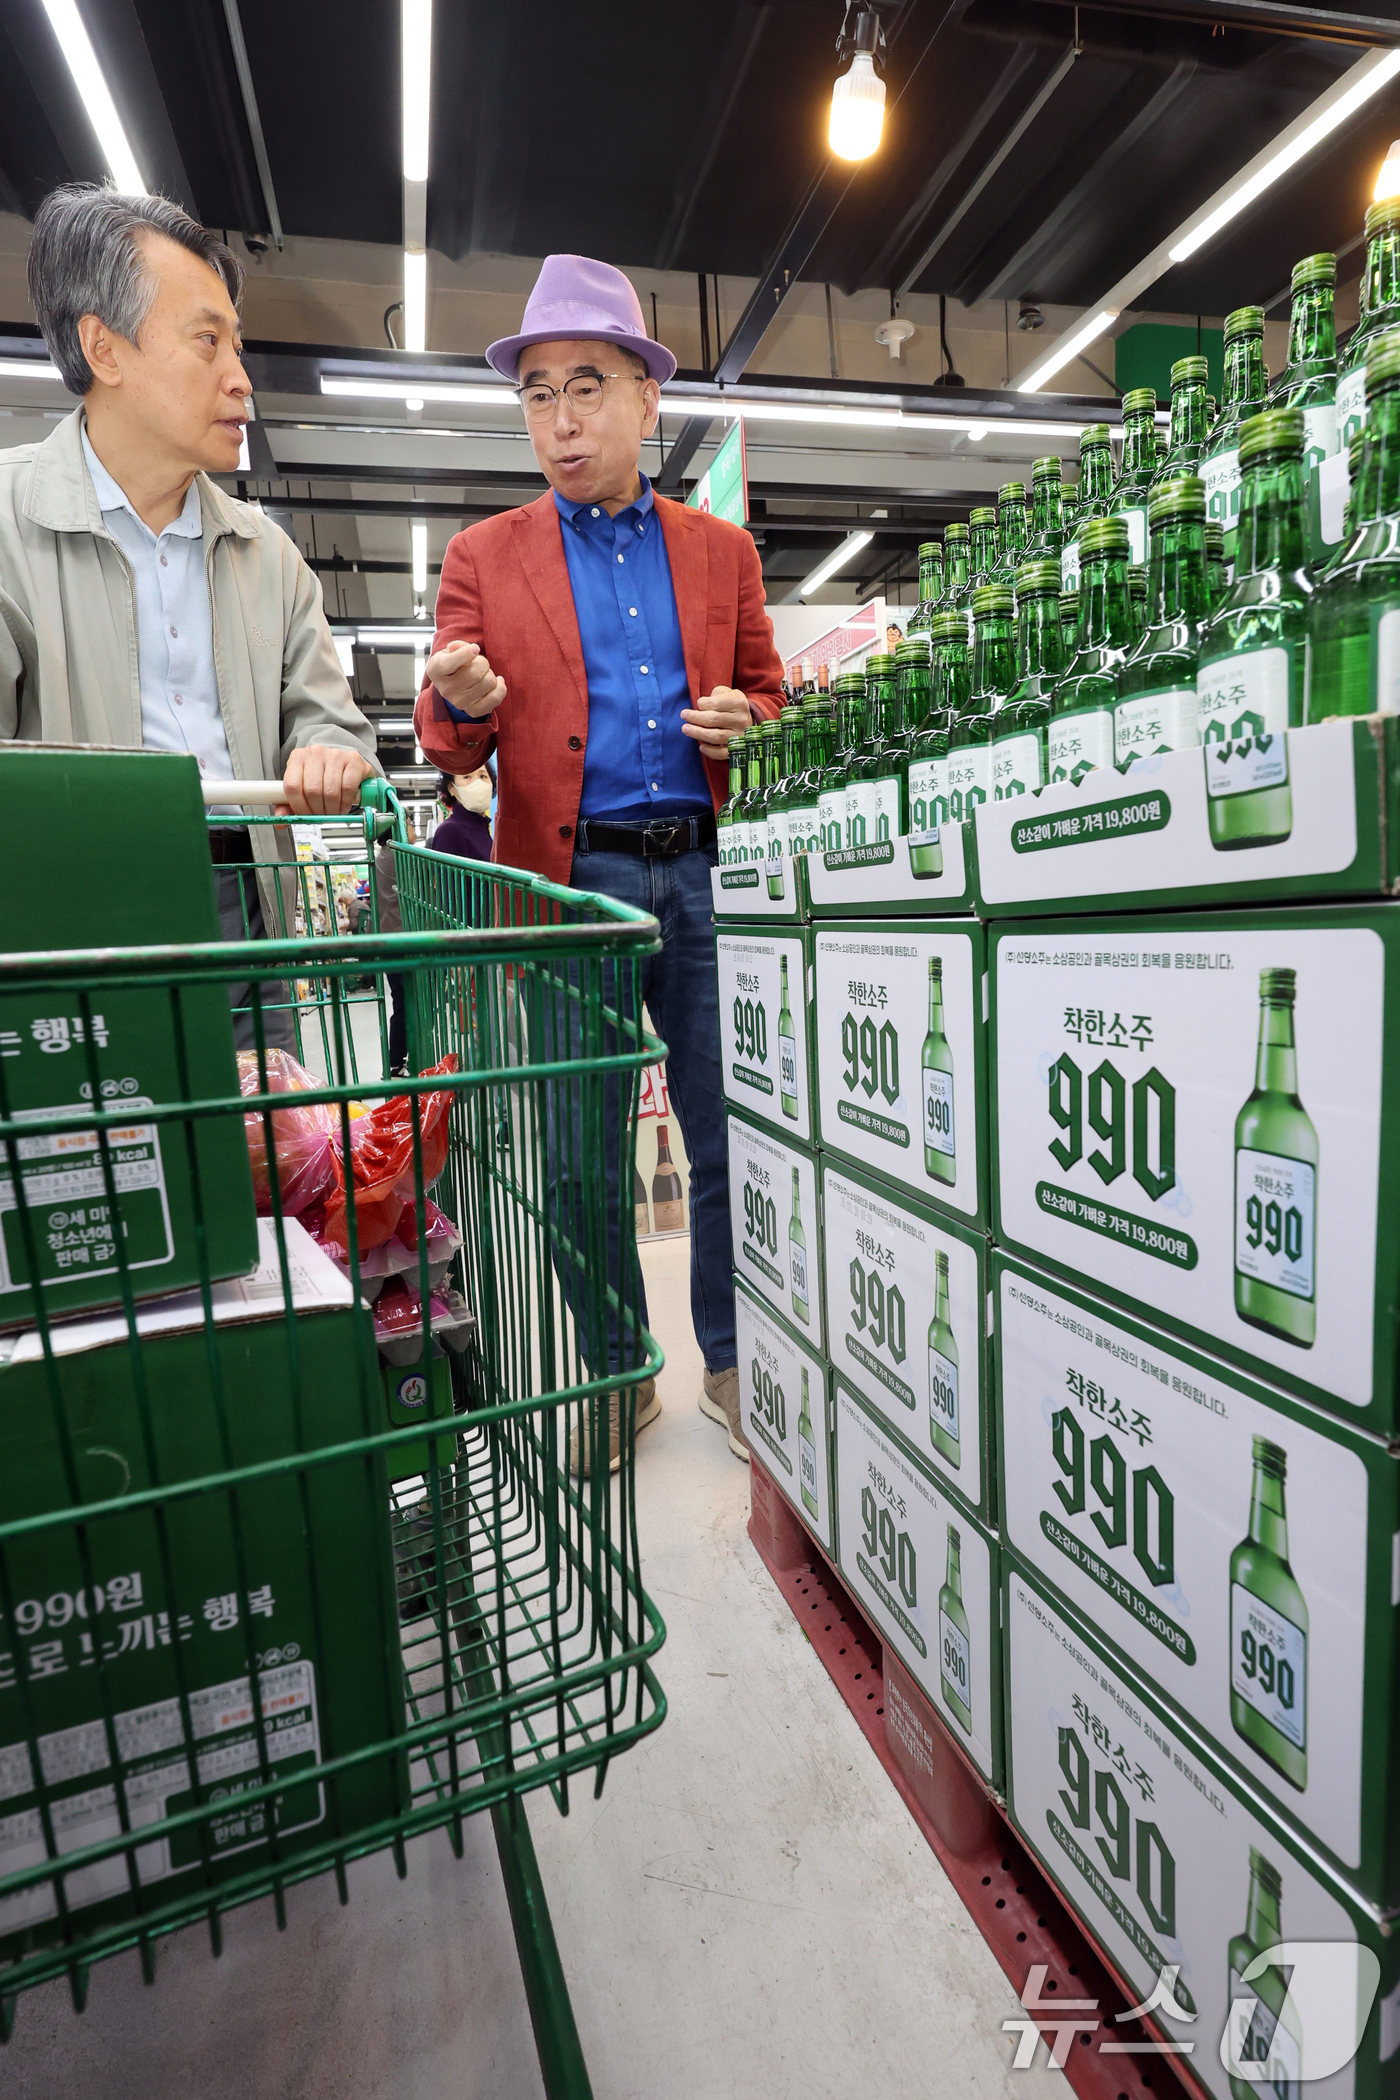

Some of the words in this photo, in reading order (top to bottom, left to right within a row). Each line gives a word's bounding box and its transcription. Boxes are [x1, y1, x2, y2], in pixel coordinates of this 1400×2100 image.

[1205, 467, 1241, 490] 한소주
[1198, 684, 1247, 715] 한소주
[994, 760, 1014, 780] 소주
[1050, 738, 1083, 761] 한소주
[948, 768, 975, 785] 한소주
[788, 822, 814, 834] 한소주
[1017, 823, 1051, 845] 산소같이
[1052, 818, 1081, 838] 가벼운
[1082, 813, 1103, 833] 가격
[1105, 800, 1161, 829] 19,800원
[866, 845, 890, 859] 19,800원
[736, 972, 760, 994] 착한소주
[1053, 952, 1092, 967] 소상공인과
[1141, 953, 1171, 969] 회복을
[1174, 954, 1234, 970] 응원합니다.
[847, 980, 888, 1010] 착한소주
[30, 1015, 110, 1054] 행복
[733, 995, 768, 1066] 990
[1064, 1007, 1154, 1052] 착한소주
[842, 1012, 900, 1107] 990
[927, 1096, 950, 1136] 990
[1048, 1052, 1176, 1202] 990
[116, 1147, 148, 1162] kcal
[747, 1158, 771, 1189] 착한소주
[47, 1220, 128, 1250] 청소년에
[743, 1180, 778, 1258] 990
[1041, 1189, 1077, 1214] 산소같이
[1078, 1202, 1107, 1228] 가벼운
[1109, 1214, 1130, 1238] 가격
[1131, 1223, 1188, 1261] 19,800원
[1246, 1194, 1302, 1263] 990
[855, 1228, 895, 1273] 착한소주
[850, 1256, 906, 1365] 990
[1054, 1310, 1093, 1342] 소상공인과
[1140, 1357, 1170, 1387] 회복을
[1171, 1375, 1229, 1419] 응원합니다.
[751, 1357, 786, 1442] 990
[933, 1375, 954, 1420] 990
[1065, 1367, 1153, 1448] 착한소주
[868, 1460, 908, 1519] 착한소주
[1051, 1406, 1175, 1587] 990
[861, 1486, 917, 1609] 990
[14, 1571, 144, 1636] 990원
[203, 1584, 276, 1632] 행복
[1045, 1519, 1080, 1557] 산소같이
[1080, 1548, 1110, 1586] 가벼운
[1110, 1573, 1132, 1606] 가격
[1132, 1592, 1188, 1655] 19,800원
[944, 1638, 966, 1687] 990
[1240, 1629, 1295, 1710] 990
[277, 1712, 307, 1732] kcal
[1071, 1692, 1156, 1803] 착한소주
[1058, 1726, 1176, 1939] 990
[1115, 1902, 1135, 1939] 가격
